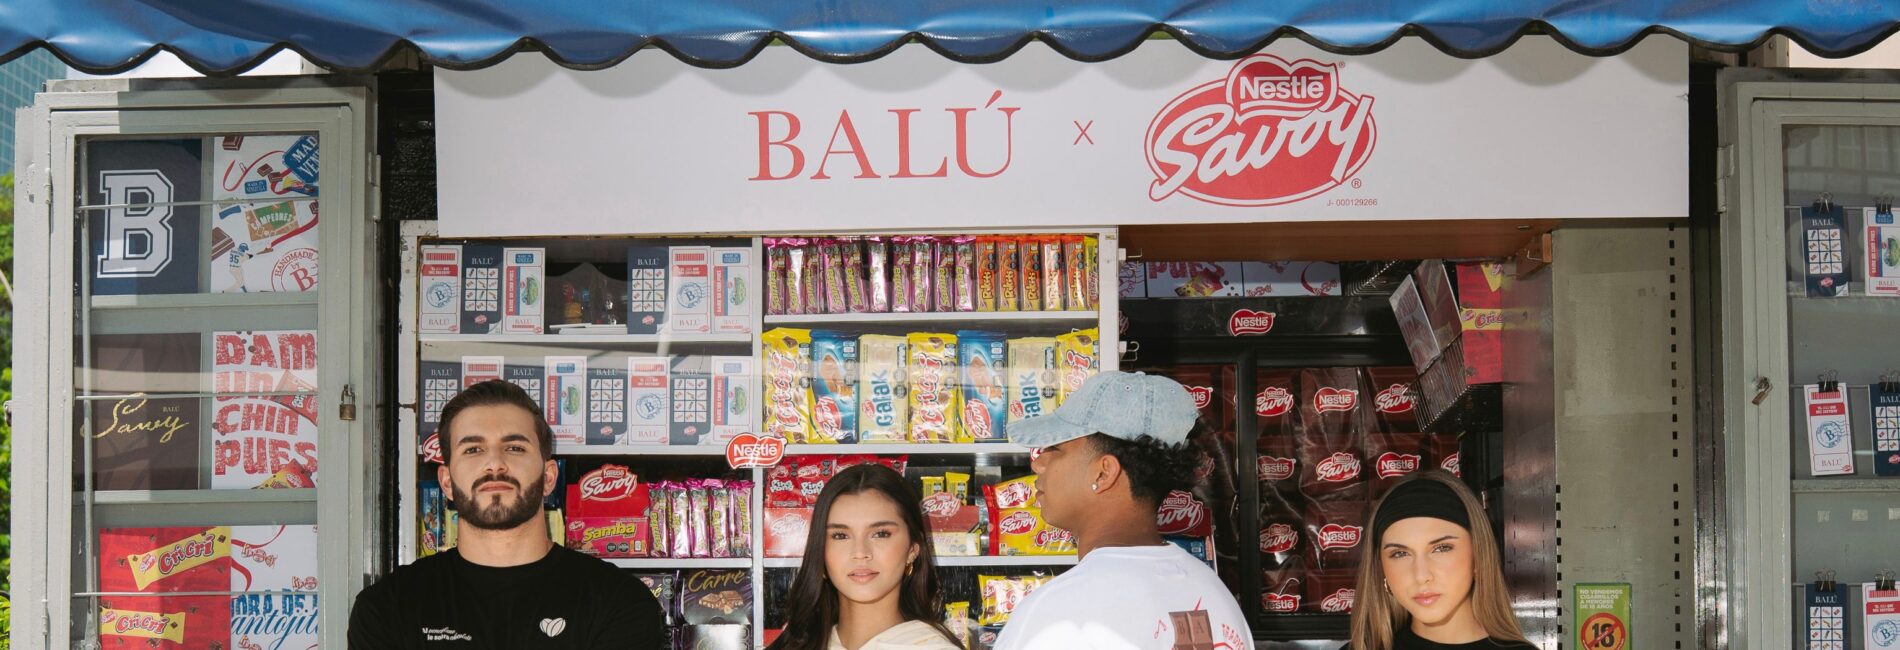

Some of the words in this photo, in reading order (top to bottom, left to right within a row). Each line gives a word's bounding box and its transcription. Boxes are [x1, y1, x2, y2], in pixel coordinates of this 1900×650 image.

[1240, 74, 1325, 100] Nestlé
[748, 90, 1021, 181] BALÚ
[1148, 95, 1375, 202] Savoy
[1336, 198, 1378, 206] 000129266
[97, 168, 174, 278] B
[274, 251, 314, 277] HANDMADE
[291, 262, 300, 270] by
[435, 290, 445, 301] B
[684, 290, 696, 302] B
[1234, 316, 1269, 328] Nestlé
[872, 369, 894, 427] Galak
[1020, 372, 1040, 420] alak
[1318, 394, 1352, 405] Nestlé
[644, 401, 654, 412] B
[1824, 430, 1835, 442] B
[214, 436, 318, 476] PUES
[734, 442, 778, 458] Nestlé
[1316, 460, 1360, 481] Savoy
[1381, 460, 1416, 471] Nestlé
[581, 474, 638, 500] Savoy
[1157, 504, 1200, 528] avoy
[582, 522, 636, 543] Samba
[1000, 517, 1036, 535] Savoy
[1323, 530, 1356, 542] Nestlé
[1816, 594, 1838, 604] BALÚ
[1591, 623, 1615, 648] 18
[1880, 628, 1890, 640] B
